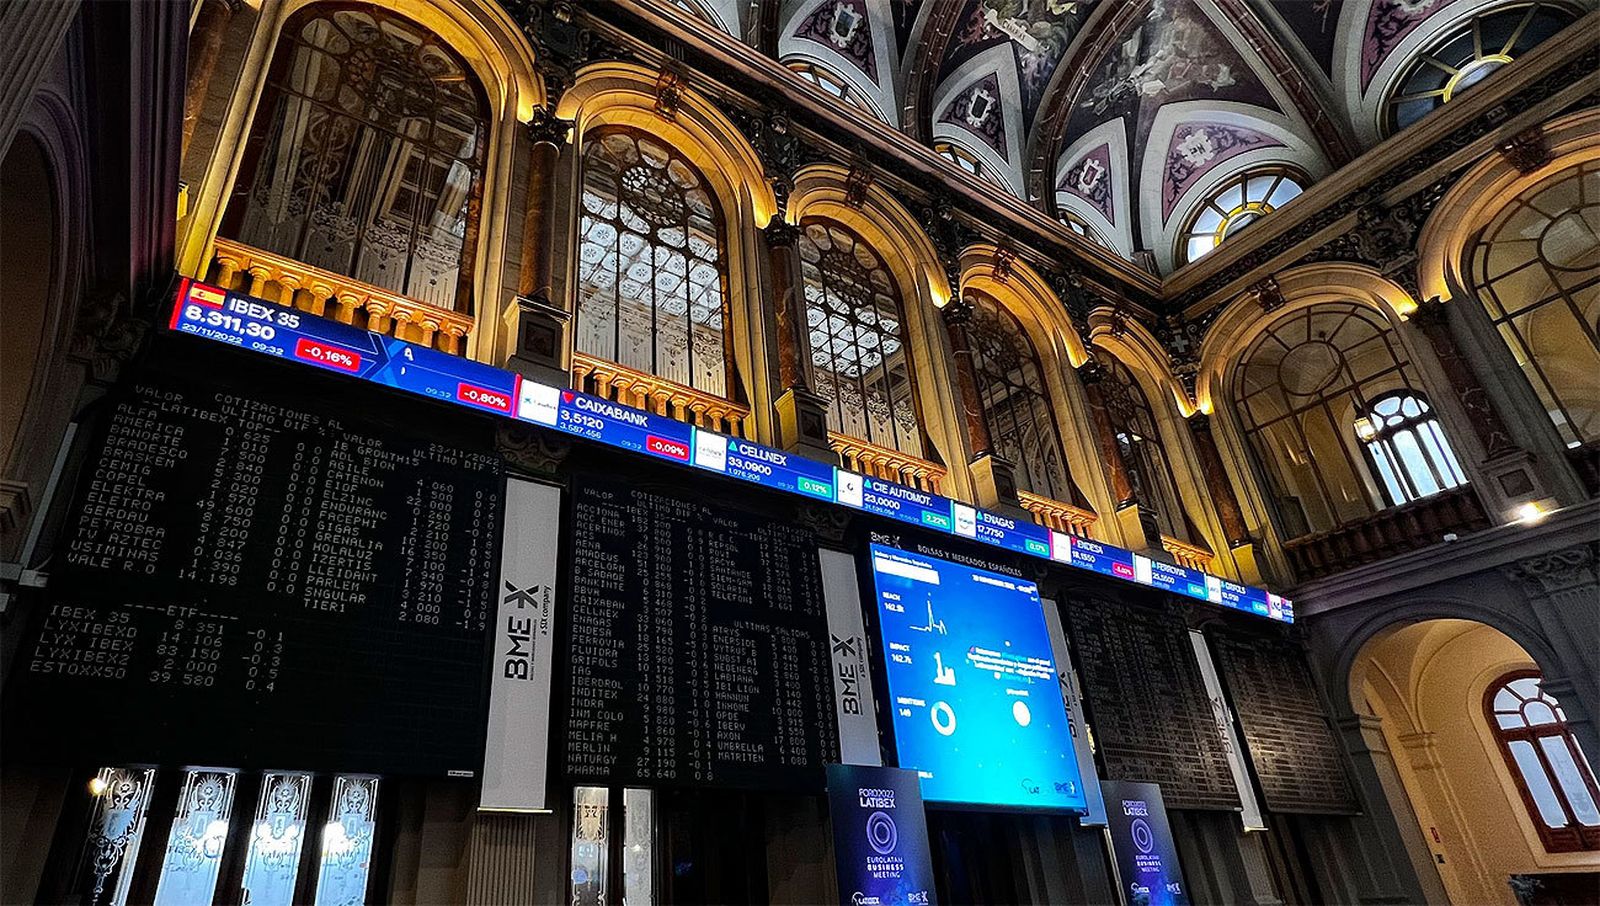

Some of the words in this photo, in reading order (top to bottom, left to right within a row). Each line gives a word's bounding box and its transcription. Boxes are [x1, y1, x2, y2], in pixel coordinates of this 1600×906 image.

[229, 298, 276, 322] IBEX
[277, 312, 300, 329] 35
[184, 305, 275, 341] 8.311,30
[181, 322, 243, 346] 23/11/2022
[251, 341, 284, 356] 09:32
[304, 347, 353, 366] -0,16%
[135, 384, 184, 403] VALOR
[214, 393, 321, 425] COTIZACIONES
[328, 419, 344, 431] AL
[463, 390, 507, 408] -0,80%
[117, 403, 158, 418] ALFA
[221, 405, 276, 424] ULTIMO
[283, 416, 310, 431] DIF
[575, 397, 649, 428] CAIXABANK
[113, 414, 185, 437] AMERICA
[560, 409, 604, 430] 3,5120
[109, 424, 182, 447] BANORTE
[105, 435, 188, 459] BRADESCO
[342, 433, 384, 449] VALOR
[429, 443, 500, 466] 23/11/2022
[651, 442, 685, 457] -0,09%
[739, 444, 788, 466] CELLNEX
[102, 446, 175, 468] BRASKEM
[330, 450, 354, 462] ADL
[363, 456, 396, 471] BION
[412, 449, 458, 466] ULTIMO
[464, 460, 485, 472] DIF
[99, 457, 151, 476] CEMIG
[328, 459, 369, 475] AGILE
[728, 456, 772, 476] 33,0900
[95, 468, 146, 487] COPEL
[326, 469, 385, 488] CATENON
[91, 480, 166, 501] ELEKTRA
[322, 490, 374, 506] ELZINC
[872, 482, 889, 494] CIE
[889, 486, 933, 507] AUTOMOT.
[87, 492, 152, 511] ELETRO
[321, 500, 388, 520] ENDURANC
[864, 493, 900, 510] 23,0000
[83, 504, 149, 523] GERDAU
[318, 510, 378, 529] FACEPHI
[576, 503, 620, 519] ACCIONA
[79, 515, 166, 538] PETROBRA
[316, 521, 360, 536] GIGAS
[576, 520, 625, 537] ACERINOX
[983, 513, 1015, 530] ENAGAS
[78, 528, 98, 539] TV
[108, 532, 163, 550] AZTEC
[1077, 540, 1104, 554] ENDESA
[70, 540, 159, 562] USIMINAS
[313, 542, 374, 560] HOLALUZ
[575, 548, 619, 562] AMADEUS
[917, 544, 944, 558] BOLSAS
[951, 553, 987, 569] MERCADOS
[67, 552, 112, 569] VALE
[311, 553, 372, 570] IZERTIS
[308, 563, 378, 583] LLEIDANT
[306, 575, 361, 591] PARLEM
[573, 585, 601, 597] BBVA
[574, 575, 625, 592] BANKINTE
[304, 587, 367, 604] SNGULAR
[542, 585, 552, 618] company
[573, 594, 625, 610] CAIXABAN
[303, 599, 346, 612] TIER1
[573, 604, 619, 618] CELLNEX
[50, 605, 97, 620] IBEX
[107, 611, 131, 624] 35
[572, 614, 612, 628] ENAGAS
[572, 624, 612, 637] ENDESA
[39, 632, 77, 646] LYX
[88, 636, 135, 651] IBEX
[571, 634, 625, 649] FERROVIA
[34, 646, 130, 665] LYXIBEX2
[571, 644, 618, 658] FLUIDRA
[30, 660, 127, 679] ESTOXX50
[571, 654, 618, 668] GRIFOLS
[571, 665, 592, 676] IAG
[571, 675, 624, 690] IBERDROL
[571, 686, 618, 700] INDITEX
[570, 697, 604, 709] INDRA
[570, 708, 591, 718] INM
[597, 710, 624, 721] COLO
[569, 719, 611, 731] MAPFRE
[568, 730, 604, 741] MELIA
[567, 741, 611, 754] MERLIN
[567, 753, 617, 765] NATURGY
[567, 764, 611, 776] PHARMA
[860, 797, 896, 808] LATIBEX
[867, 864, 904, 872] BUSINESS
